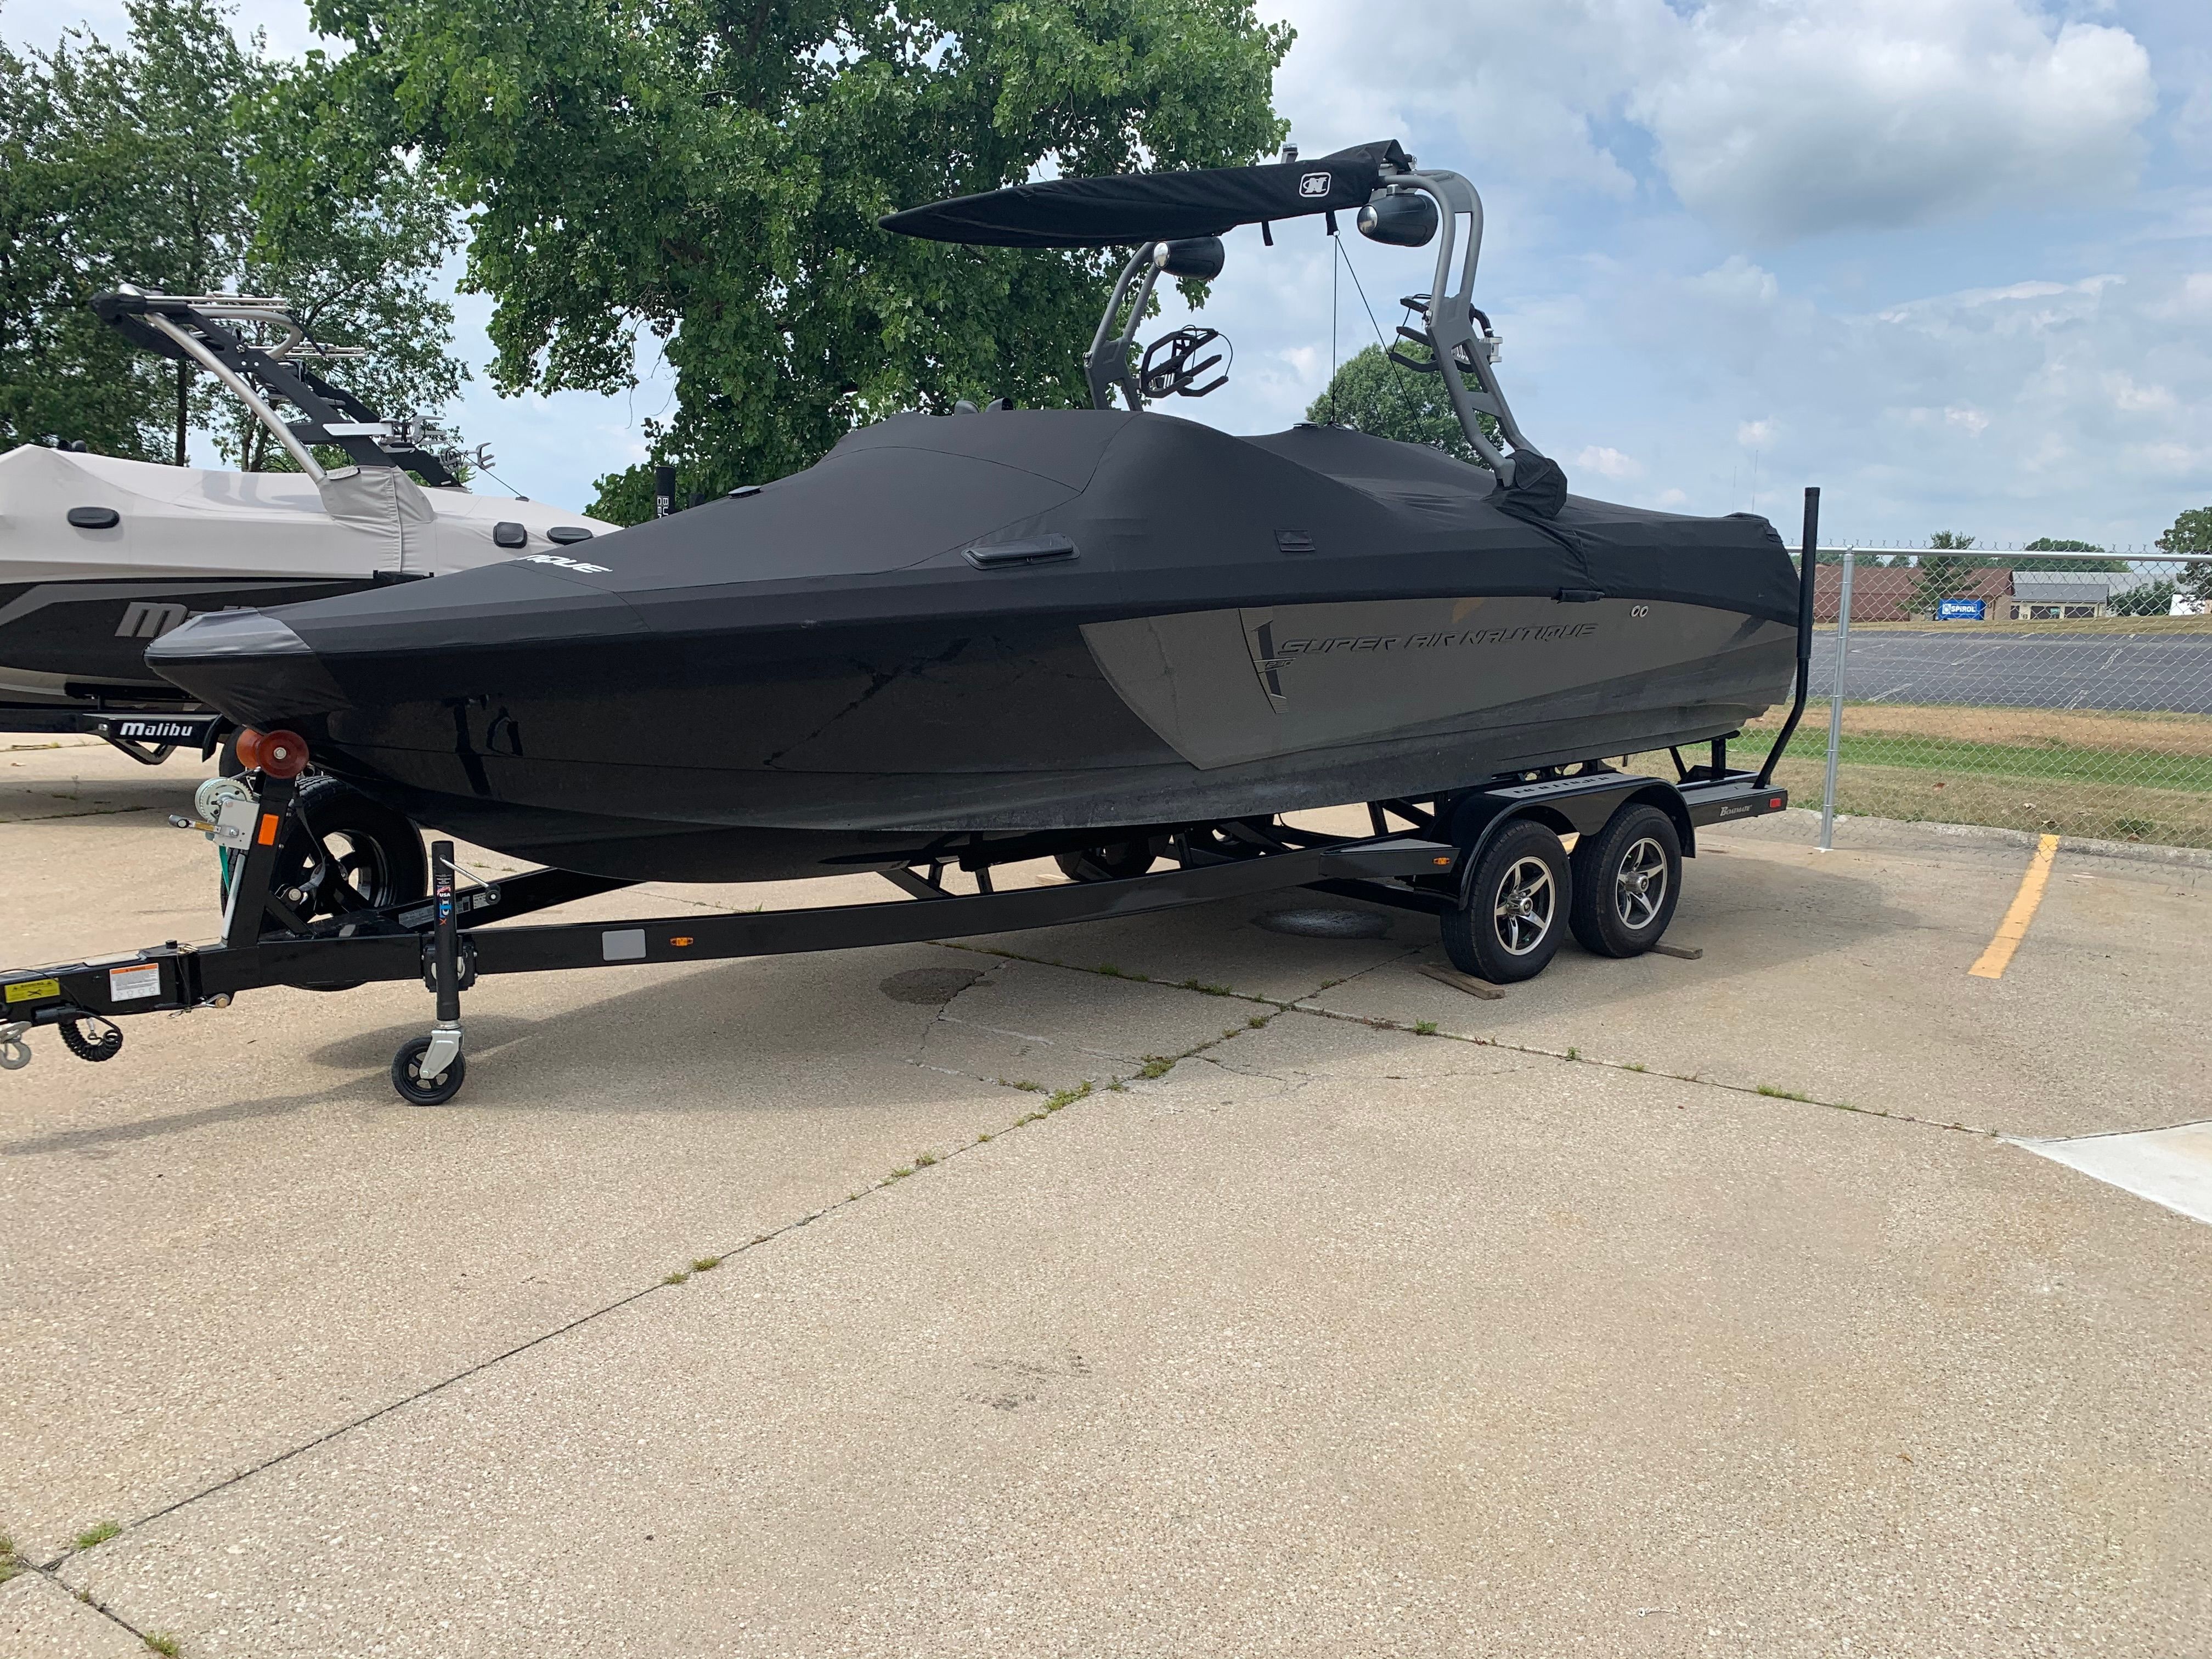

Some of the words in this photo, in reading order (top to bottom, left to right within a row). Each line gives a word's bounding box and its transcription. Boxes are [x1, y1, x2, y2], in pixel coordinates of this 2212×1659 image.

[1277, 635, 1401, 654] SUPER
[1404, 630, 1460, 649] AIR
[1459, 623, 1599, 645] NAUTIQUE
